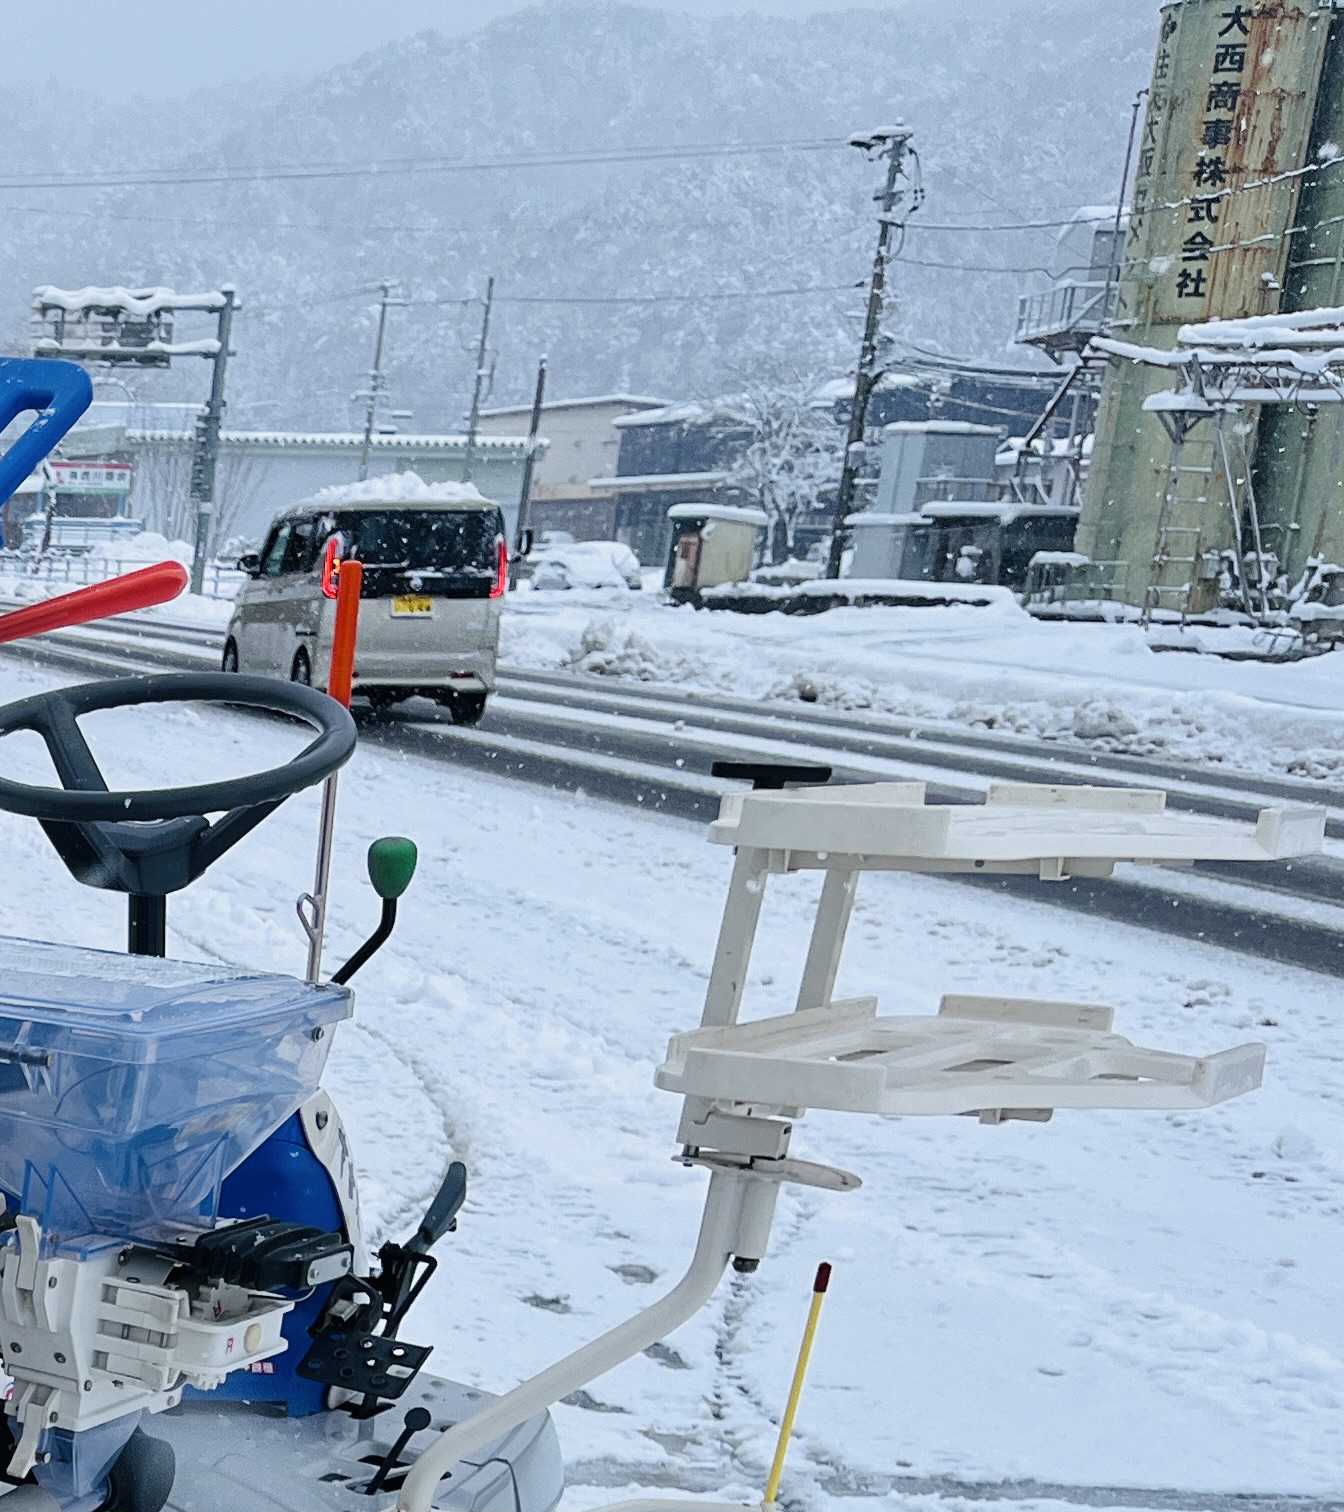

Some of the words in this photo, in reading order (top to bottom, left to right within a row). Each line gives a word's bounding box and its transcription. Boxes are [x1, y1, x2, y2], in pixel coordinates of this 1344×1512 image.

[1176, 4, 1253, 299] 大西商事株式会社
